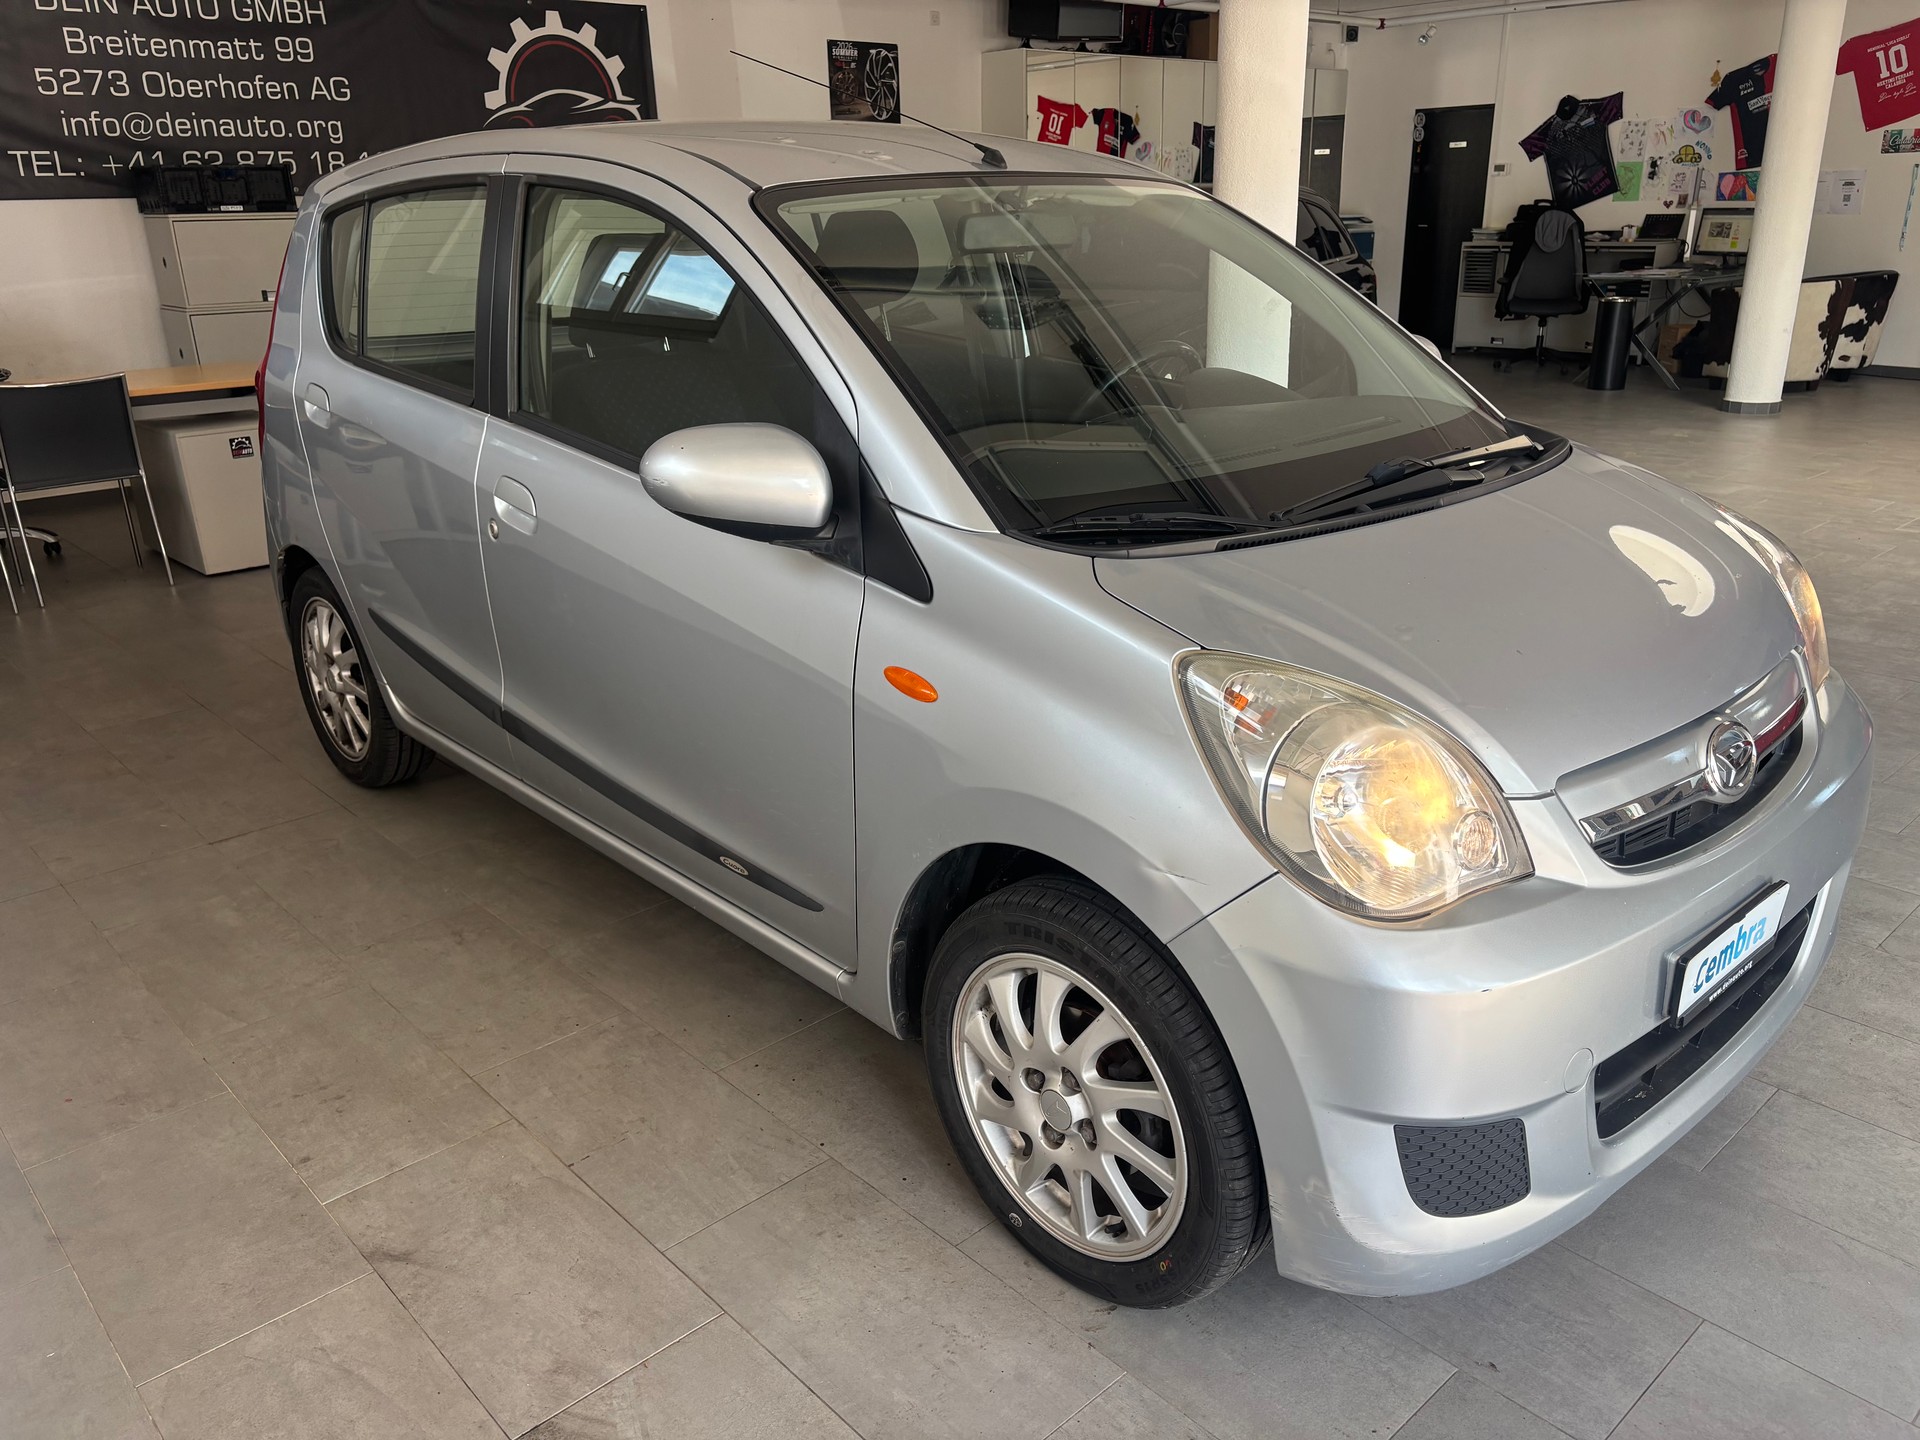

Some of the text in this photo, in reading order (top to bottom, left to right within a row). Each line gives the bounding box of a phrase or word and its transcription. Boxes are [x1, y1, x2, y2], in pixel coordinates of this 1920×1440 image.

[132, 0, 220, 20] AUTO
[230, 0, 327, 25] GMBH
[62, 26, 315, 63] Breitenmatt 99
[832, 48, 858, 57] SUMMER
[1876, 43, 1909, 79] 10
[34, 67, 351, 101] 5273 Oberhofen AG
[59, 109, 344, 145] info@deinauto.org
[7, 150, 86, 177] TEL:
[102, 150, 164, 177] +41
[236, 150, 298, 175] 875
[722, 858, 746, 874] Cuore
[1709, 960, 1753, 1002] www.deinauto.org
